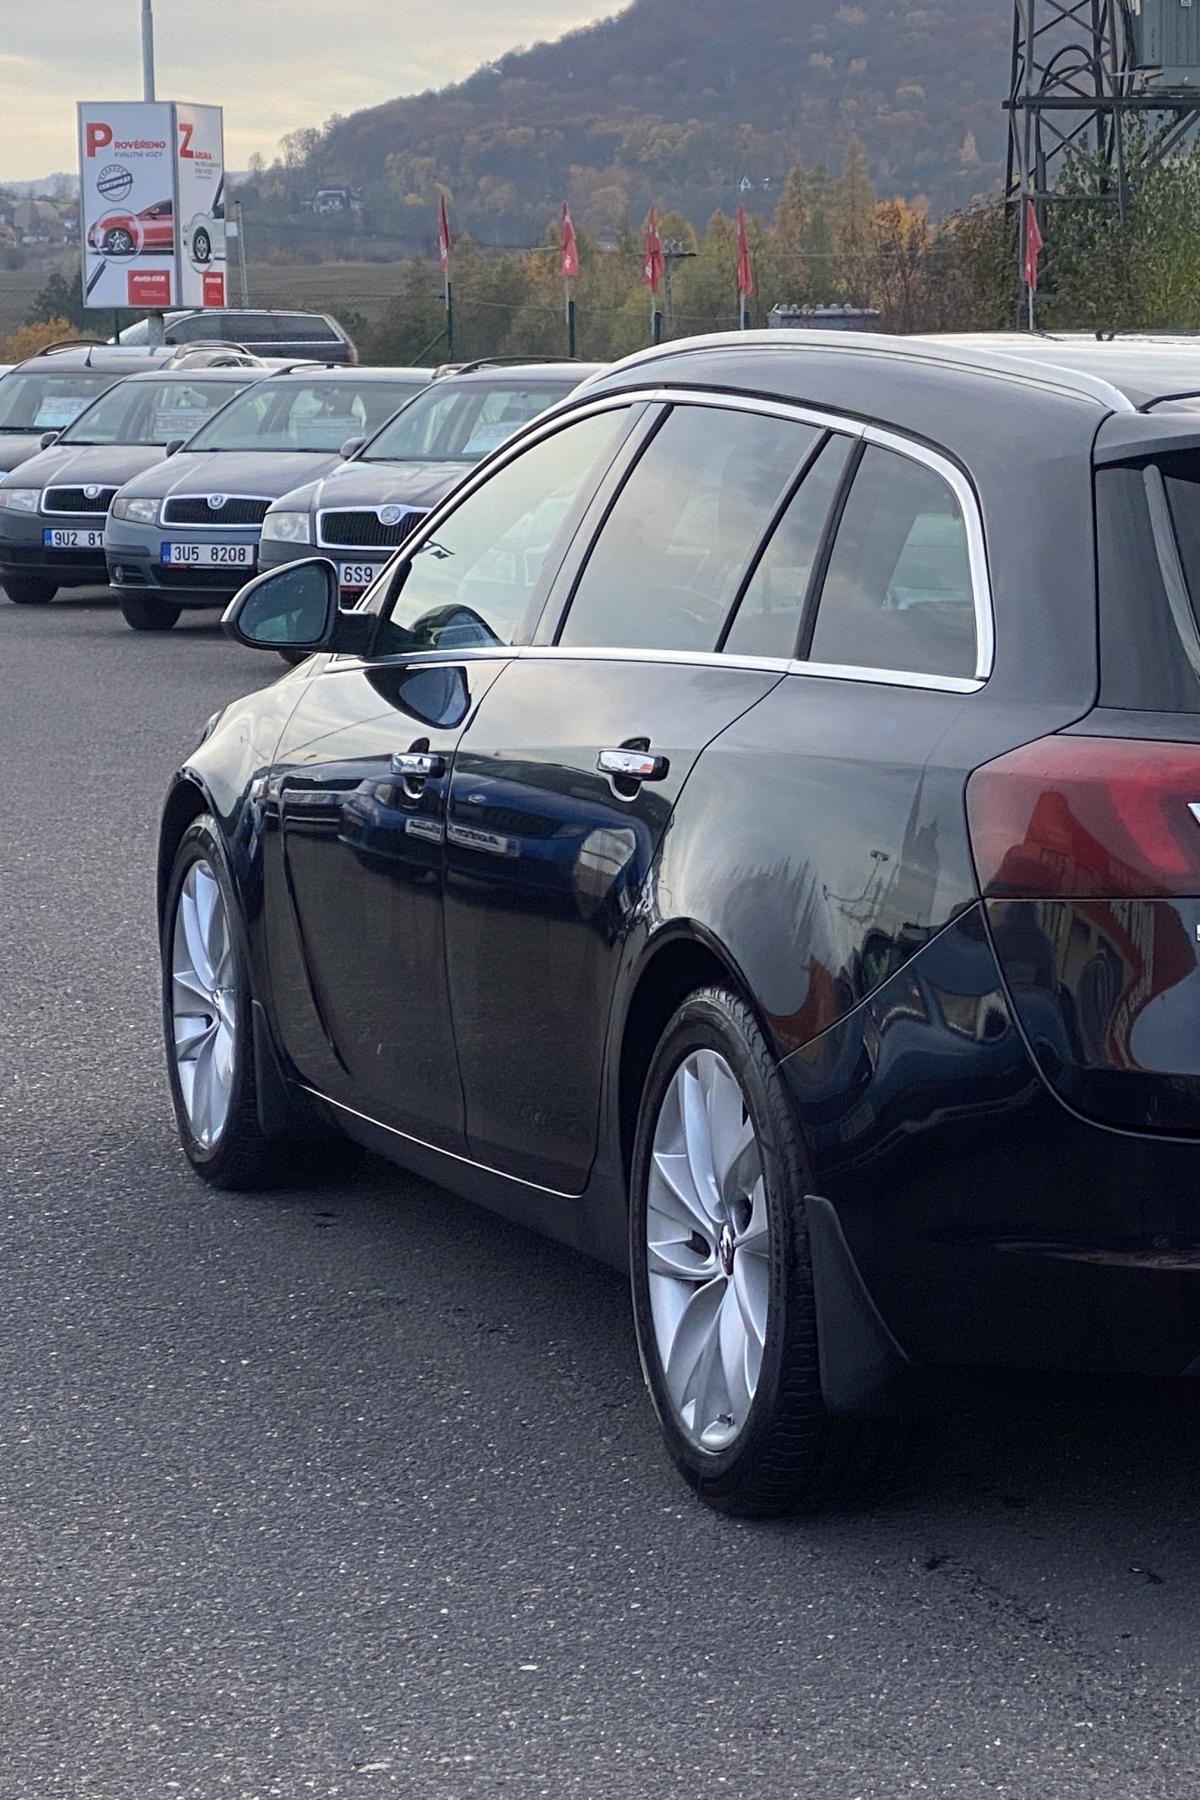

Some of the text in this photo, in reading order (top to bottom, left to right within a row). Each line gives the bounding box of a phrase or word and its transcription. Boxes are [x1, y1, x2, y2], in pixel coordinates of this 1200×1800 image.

[54, 531, 78, 546] 9U2
[174, 547, 247, 562] 3U5 8208
[343, 565, 373, 583] 6S9
